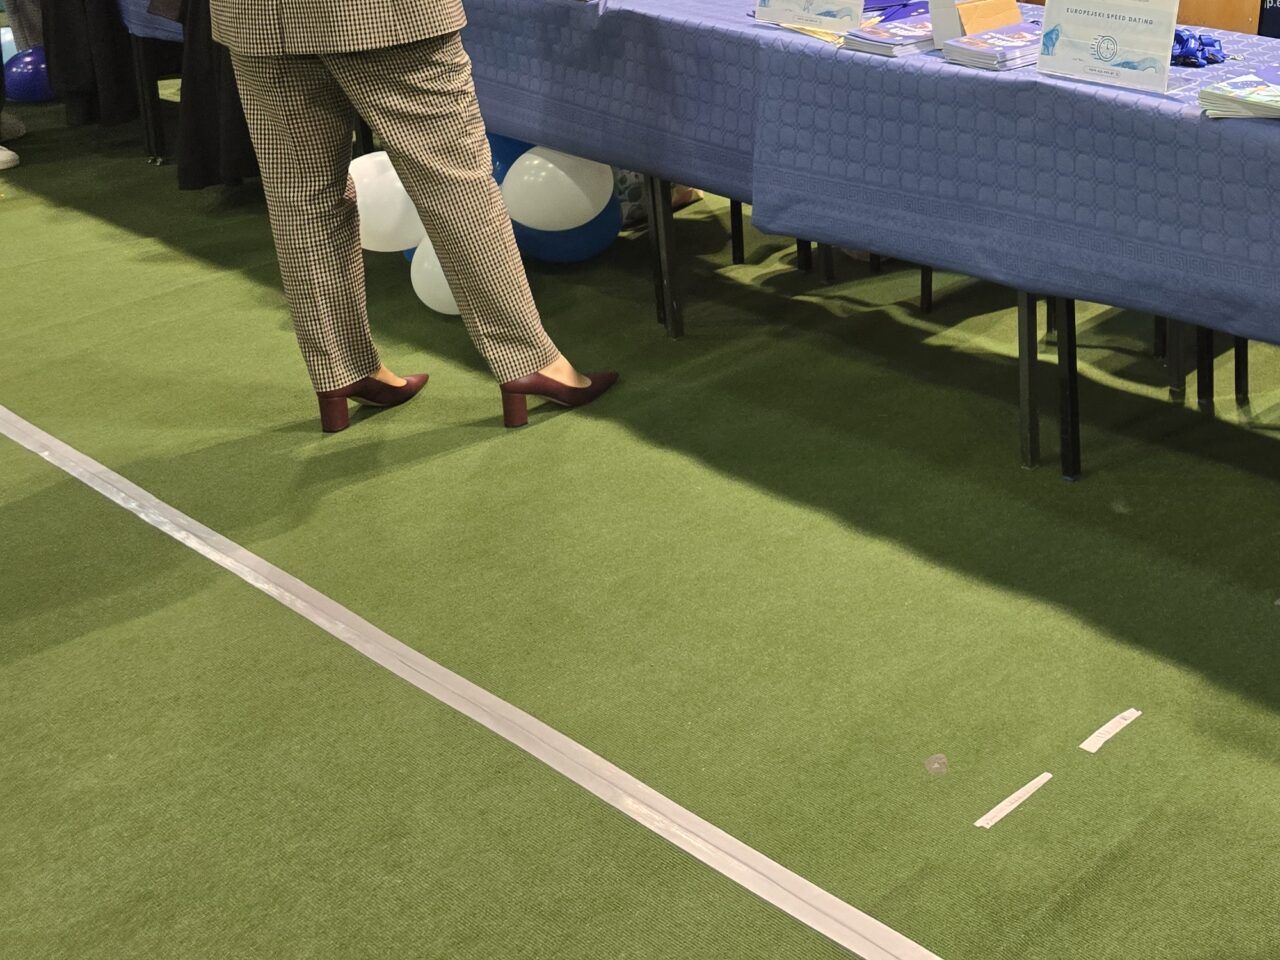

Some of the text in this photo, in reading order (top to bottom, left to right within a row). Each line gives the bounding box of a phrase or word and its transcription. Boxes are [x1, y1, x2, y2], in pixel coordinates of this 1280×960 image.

[1066, 7, 1154, 25] EUROPEJSKI SPEED DATING
